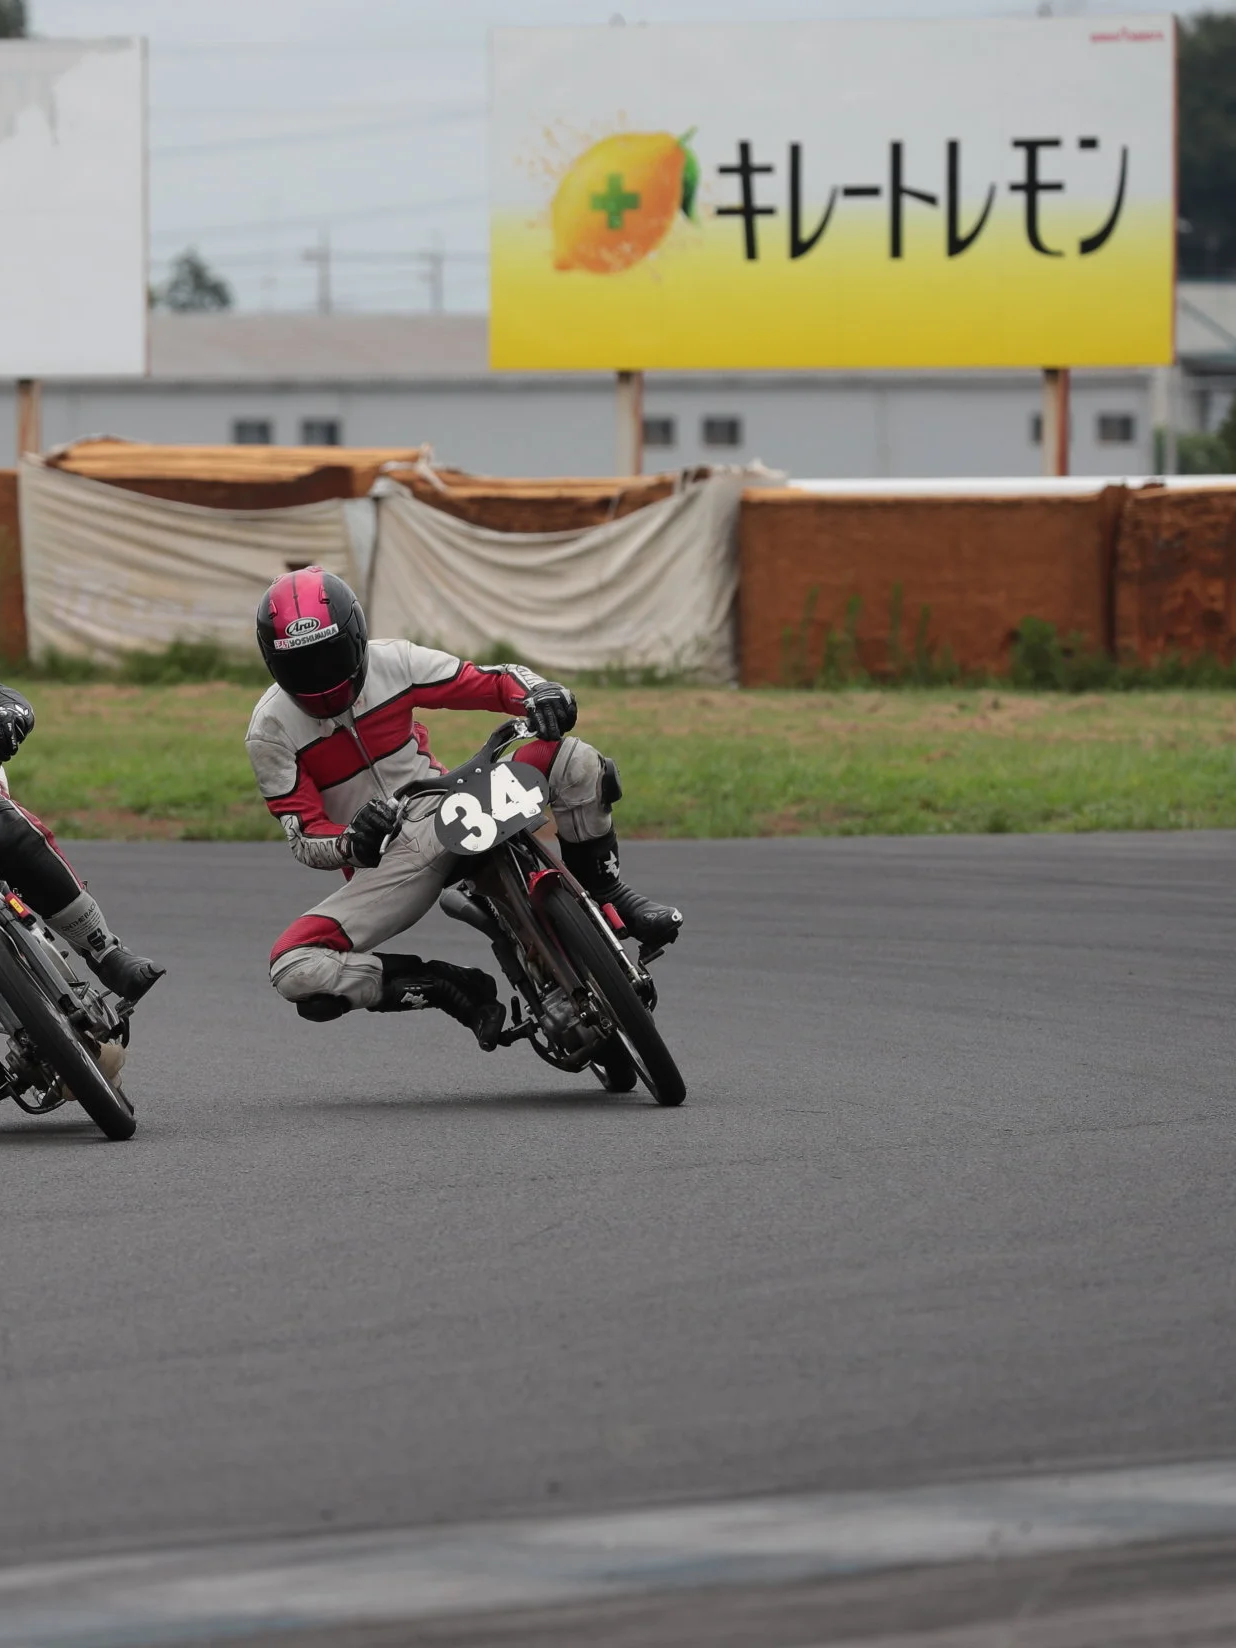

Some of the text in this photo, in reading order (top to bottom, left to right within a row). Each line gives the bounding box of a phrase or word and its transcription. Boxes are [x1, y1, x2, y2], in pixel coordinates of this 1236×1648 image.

[716, 136, 1128, 261] キレートレモン
[289, 626, 338, 647] YOSHIMURA
[440, 763, 544, 852] 34
